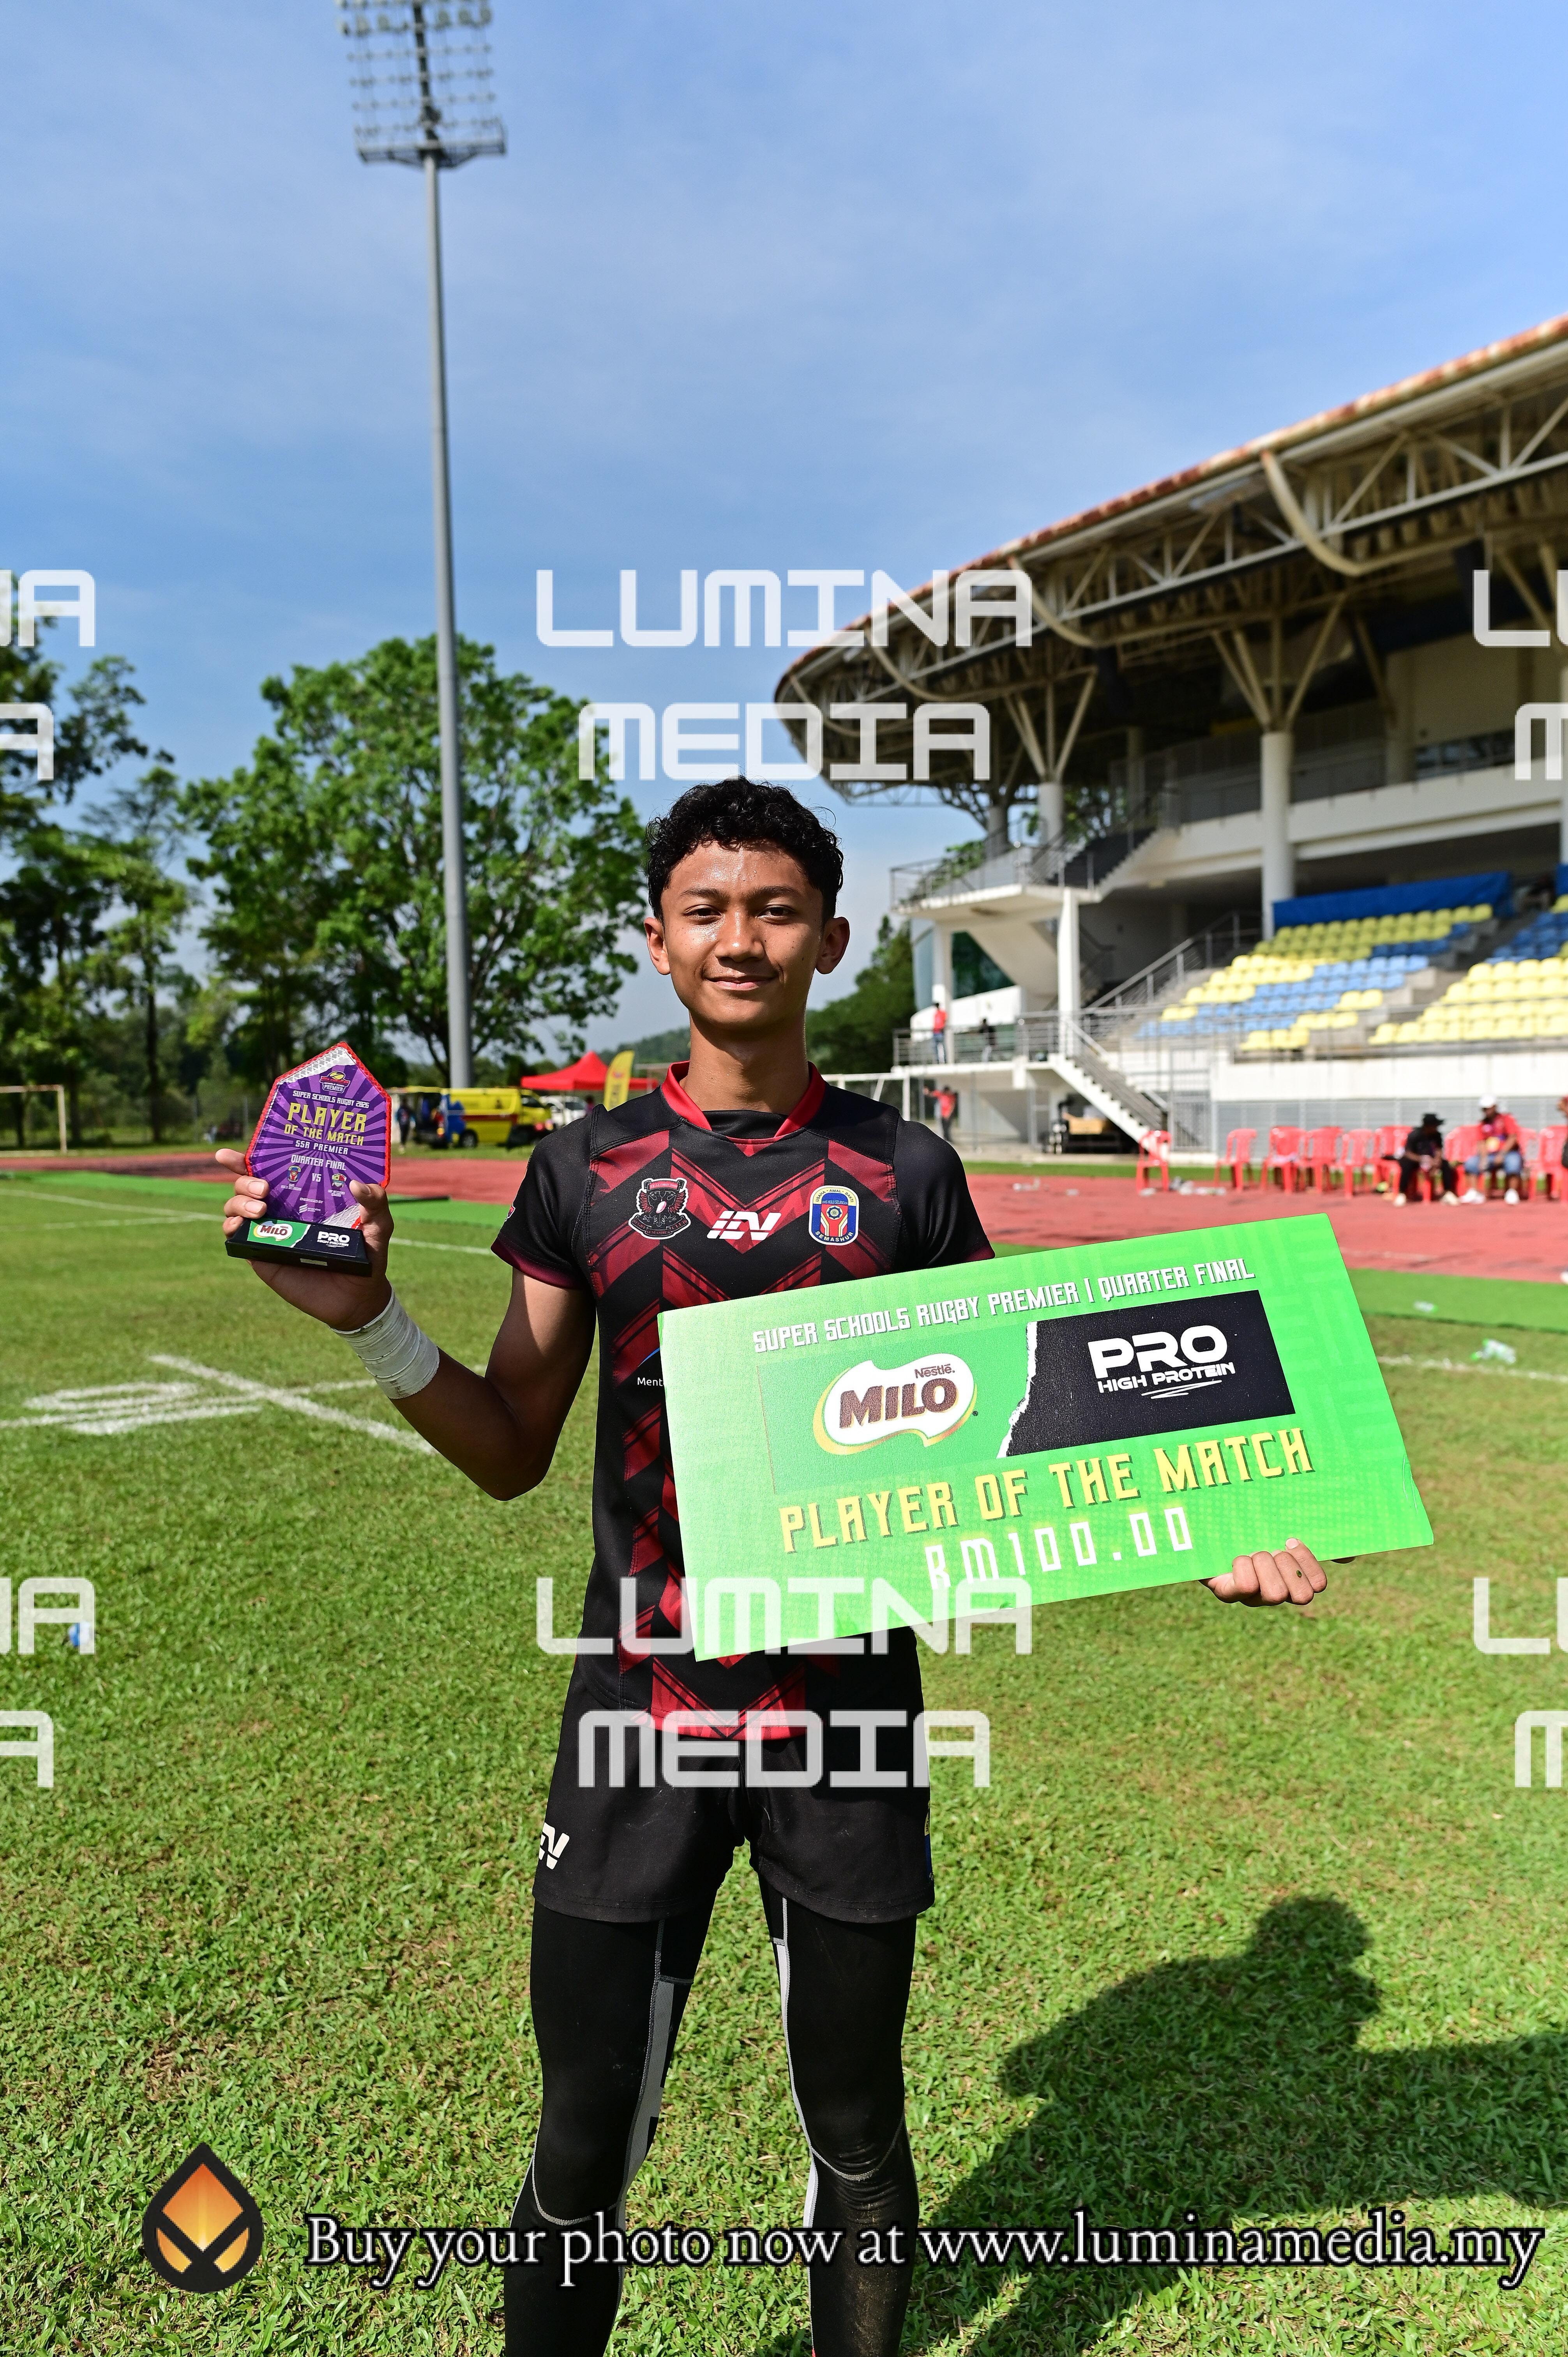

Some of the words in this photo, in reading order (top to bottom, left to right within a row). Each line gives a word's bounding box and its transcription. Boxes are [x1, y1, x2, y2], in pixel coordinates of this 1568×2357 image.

[293, 1090, 311, 1099] SUPER
[312, 1094, 335, 1103] SCHOOLS
[337, 1097, 355, 1106] RUGBY
[288, 1103, 367, 1133] PLAYER
[284, 1124, 298, 1135] OF
[303, 1127, 323, 1140] THE
[327, 1131, 364, 1146] MATCH
[295, 1140, 310, 1149] SSR
[313, 1143, 348, 1155] PREMIER
[291, 1154, 324, 1167] QUARTER
[325, 1160, 346, 1171] FINAL
[312, 1173, 322, 1182] VS
[816, 1191, 826, 1202] USAHA
[845, 1192, 854, 1203] BAKTI
[260, 1225, 288, 1235] MILO
[317, 1231, 350, 1243] PRO
[815, 1231, 853, 1242] SEMASHUR
[753, 1323, 818, 1353] SUPER
[825, 1307, 911, 1341] SCHOOLS
[916, 1297, 980, 1324] RUGBY
[988, 1282, 1080, 1315] PREMIER
[1098, 1266, 1190, 1302] QUARTER
[1194, 1258, 1255, 1285] FINAL
[1088, 1325, 1227, 1379] PRO
[1097, 1374, 1148, 1393] HIGH
[1151, 1362, 1235, 1386] PROTEIN
[839, 1378, 958, 1429] MILO
[779, 1481, 959, 1553] PLAYER
[975, 1469, 1029, 1522] OF
[1049, 1453, 1141, 1509] THE
[1153, 1428, 1316, 1495] MATCH
